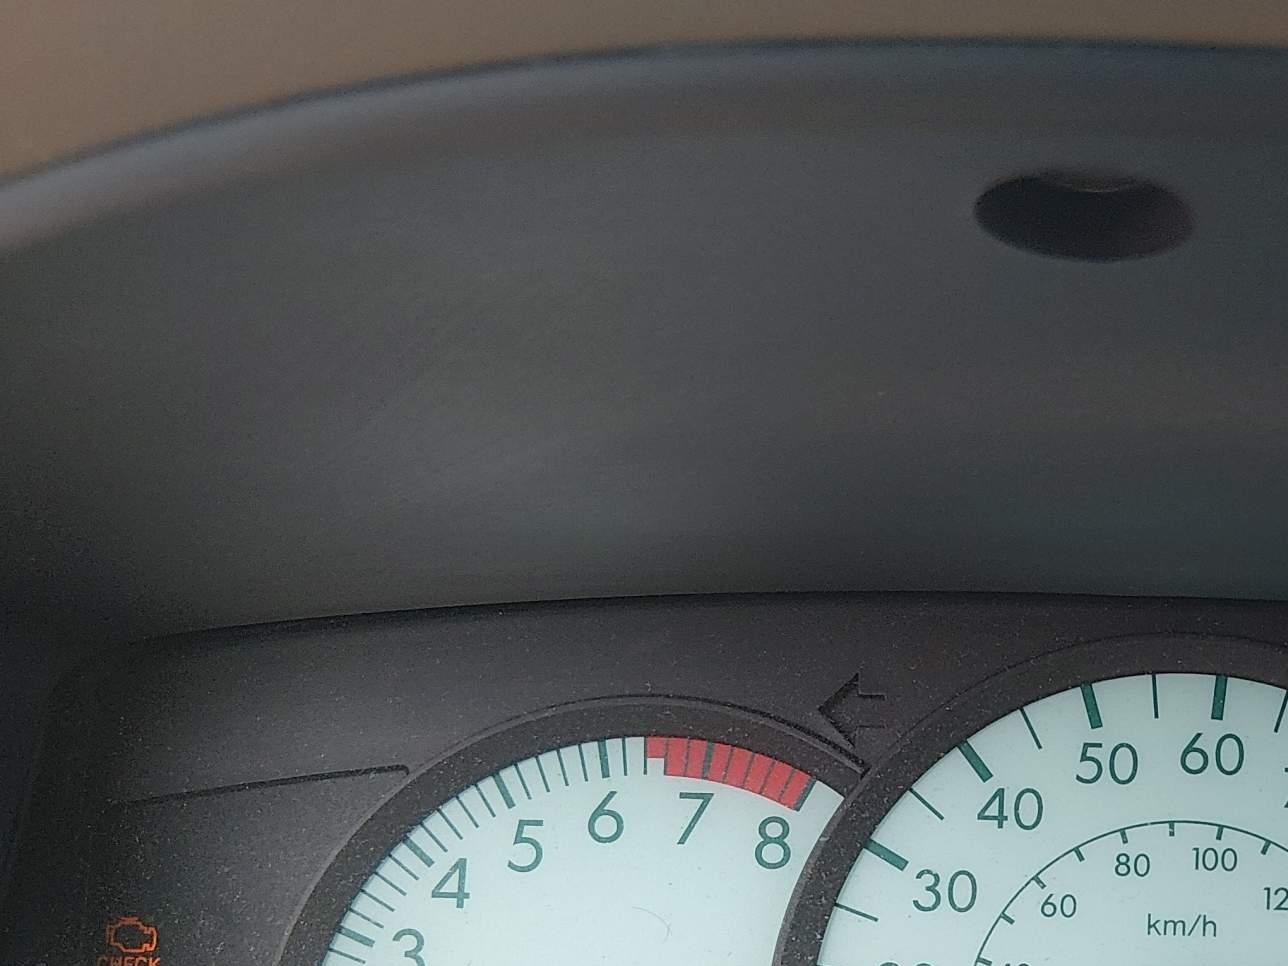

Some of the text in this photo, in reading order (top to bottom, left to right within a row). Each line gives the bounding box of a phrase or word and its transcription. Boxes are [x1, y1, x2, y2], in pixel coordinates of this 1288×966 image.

[1076, 743, 1138, 784] 50
[1181, 733, 1244, 775] 60
[588, 791, 624, 843] 6
[677, 792, 714, 844] 7
[977, 788, 1043, 830] 40
[508, 819, 543, 872] 5
[755, 816, 791, 869] 8
[1193, 848, 1237, 871] 100
[431, 858, 470, 908] 4
[1115, 853, 1150, 877] 80
[913, 869, 977, 912] 30
[1041, 894, 1076, 918] 60
[1148, 914, 1216, 937] km/h
